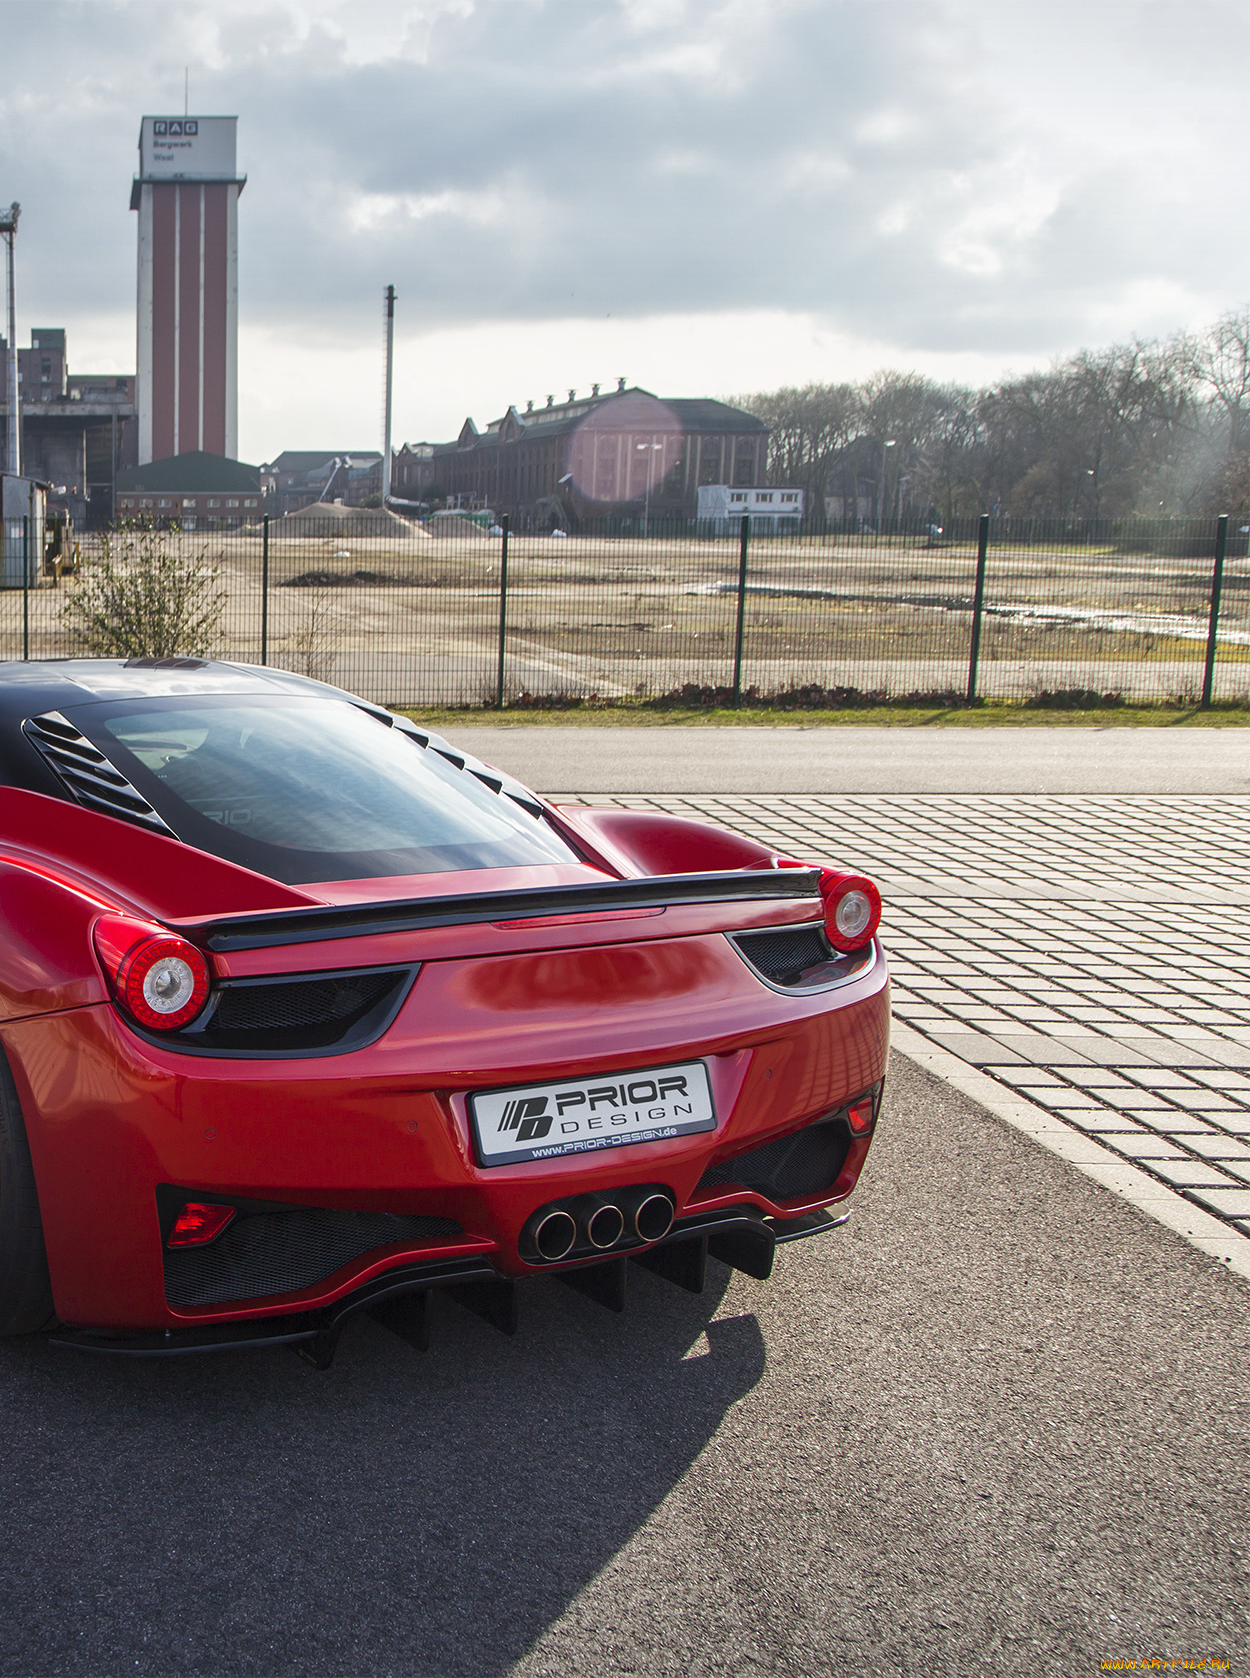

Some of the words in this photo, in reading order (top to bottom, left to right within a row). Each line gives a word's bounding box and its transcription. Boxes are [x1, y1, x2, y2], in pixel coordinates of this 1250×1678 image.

[154, 121, 197, 135] RAG
[153, 140, 192, 150] Bergwerk
[555, 1075, 689, 1116] PRIOR
[560, 1102, 693, 1134] DESIGN
[532, 1127, 678, 1158] www.PRIOR-DESIGN.de
